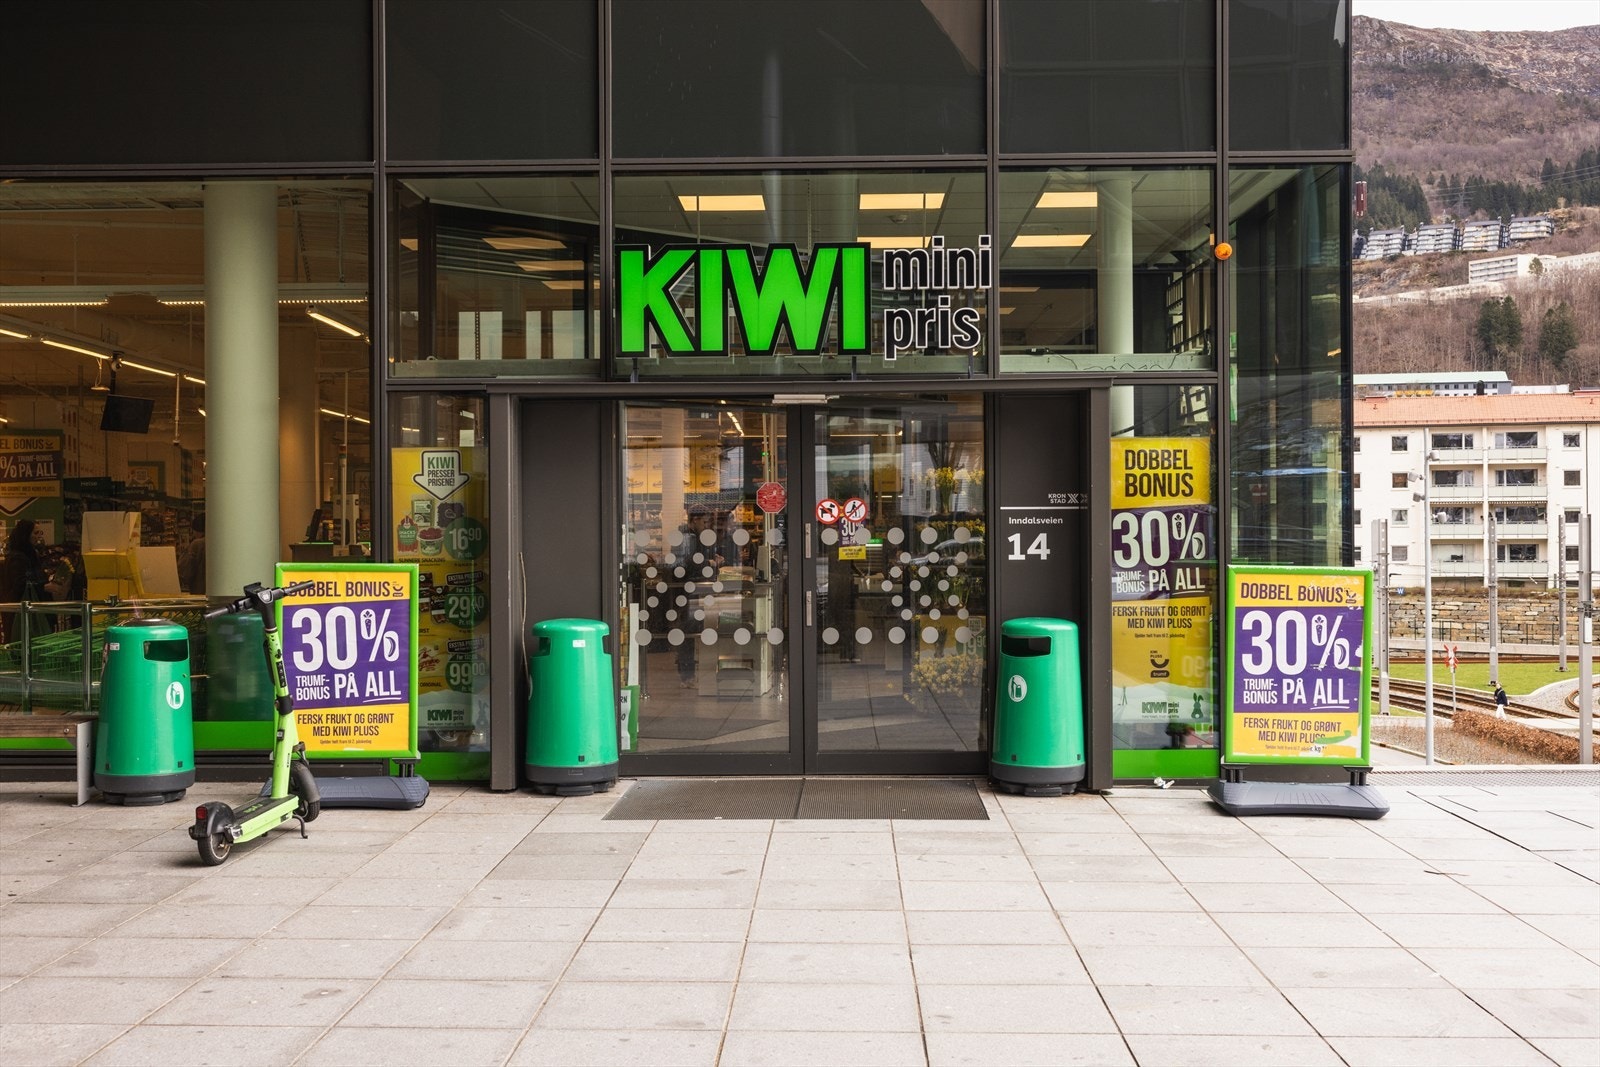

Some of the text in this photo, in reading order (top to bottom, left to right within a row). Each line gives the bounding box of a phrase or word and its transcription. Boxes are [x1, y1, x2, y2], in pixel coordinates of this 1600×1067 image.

[884, 235, 992, 290] mini
[617, 243, 871, 356] KIWI
[884, 295, 982, 360] pris
[13, 438, 44, 450] BONUS
[427, 457, 455, 469] KIWI
[1124, 449, 1193, 470] DOBBEL
[36, 462, 57, 477] ALL
[427, 478, 455, 486] PRISENE!
[1125, 472, 1194, 497] BONUS
[1008, 517, 1063, 525] Inndalsveien
[1007, 533, 1051, 560] 14
[1112, 510, 1206, 569] 30%
[1116, 570, 1145, 581] TRUMF-
[1149, 567, 1206, 592] PÅ ALL
[288, 581, 341, 598] DOBBEL
[345, 581, 391, 597] BONUS
[1116, 580, 1146, 594] BONUS
[1240, 582, 1344, 603] DOBBEL BONUS
[1112, 605, 1207, 617] FERSK FRUKT OG GRØNT
[1127, 618, 1193, 629] MED KIWI PLUSS
[291, 605, 400, 672] 30%
[1241, 609, 1350, 676] 30%
[295, 673, 330, 688] TRUMF-
[334, 670, 402, 699] PÅ ALL
[1243, 679, 1278, 690] TRUMF-
[295, 686, 331, 701] BONUS
[1243, 690, 1278, 704] BONUS
[1282, 678, 1350, 705] PÅ ALL
[427, 709, 453, 721] KIWI
[1141, 702, 1168, 713] KIWI
[297, 713, 394, 725] FERSK FRUKT OG GRØNT
[1243, 717, 1342, 732] FERSK FRUKT OG GRØNT
[312, 725, 380, 737] MED KIWI PLUSS
[1258, 730, 1276, 742] MED
[1278, 731, 1297, 743] KIWI
